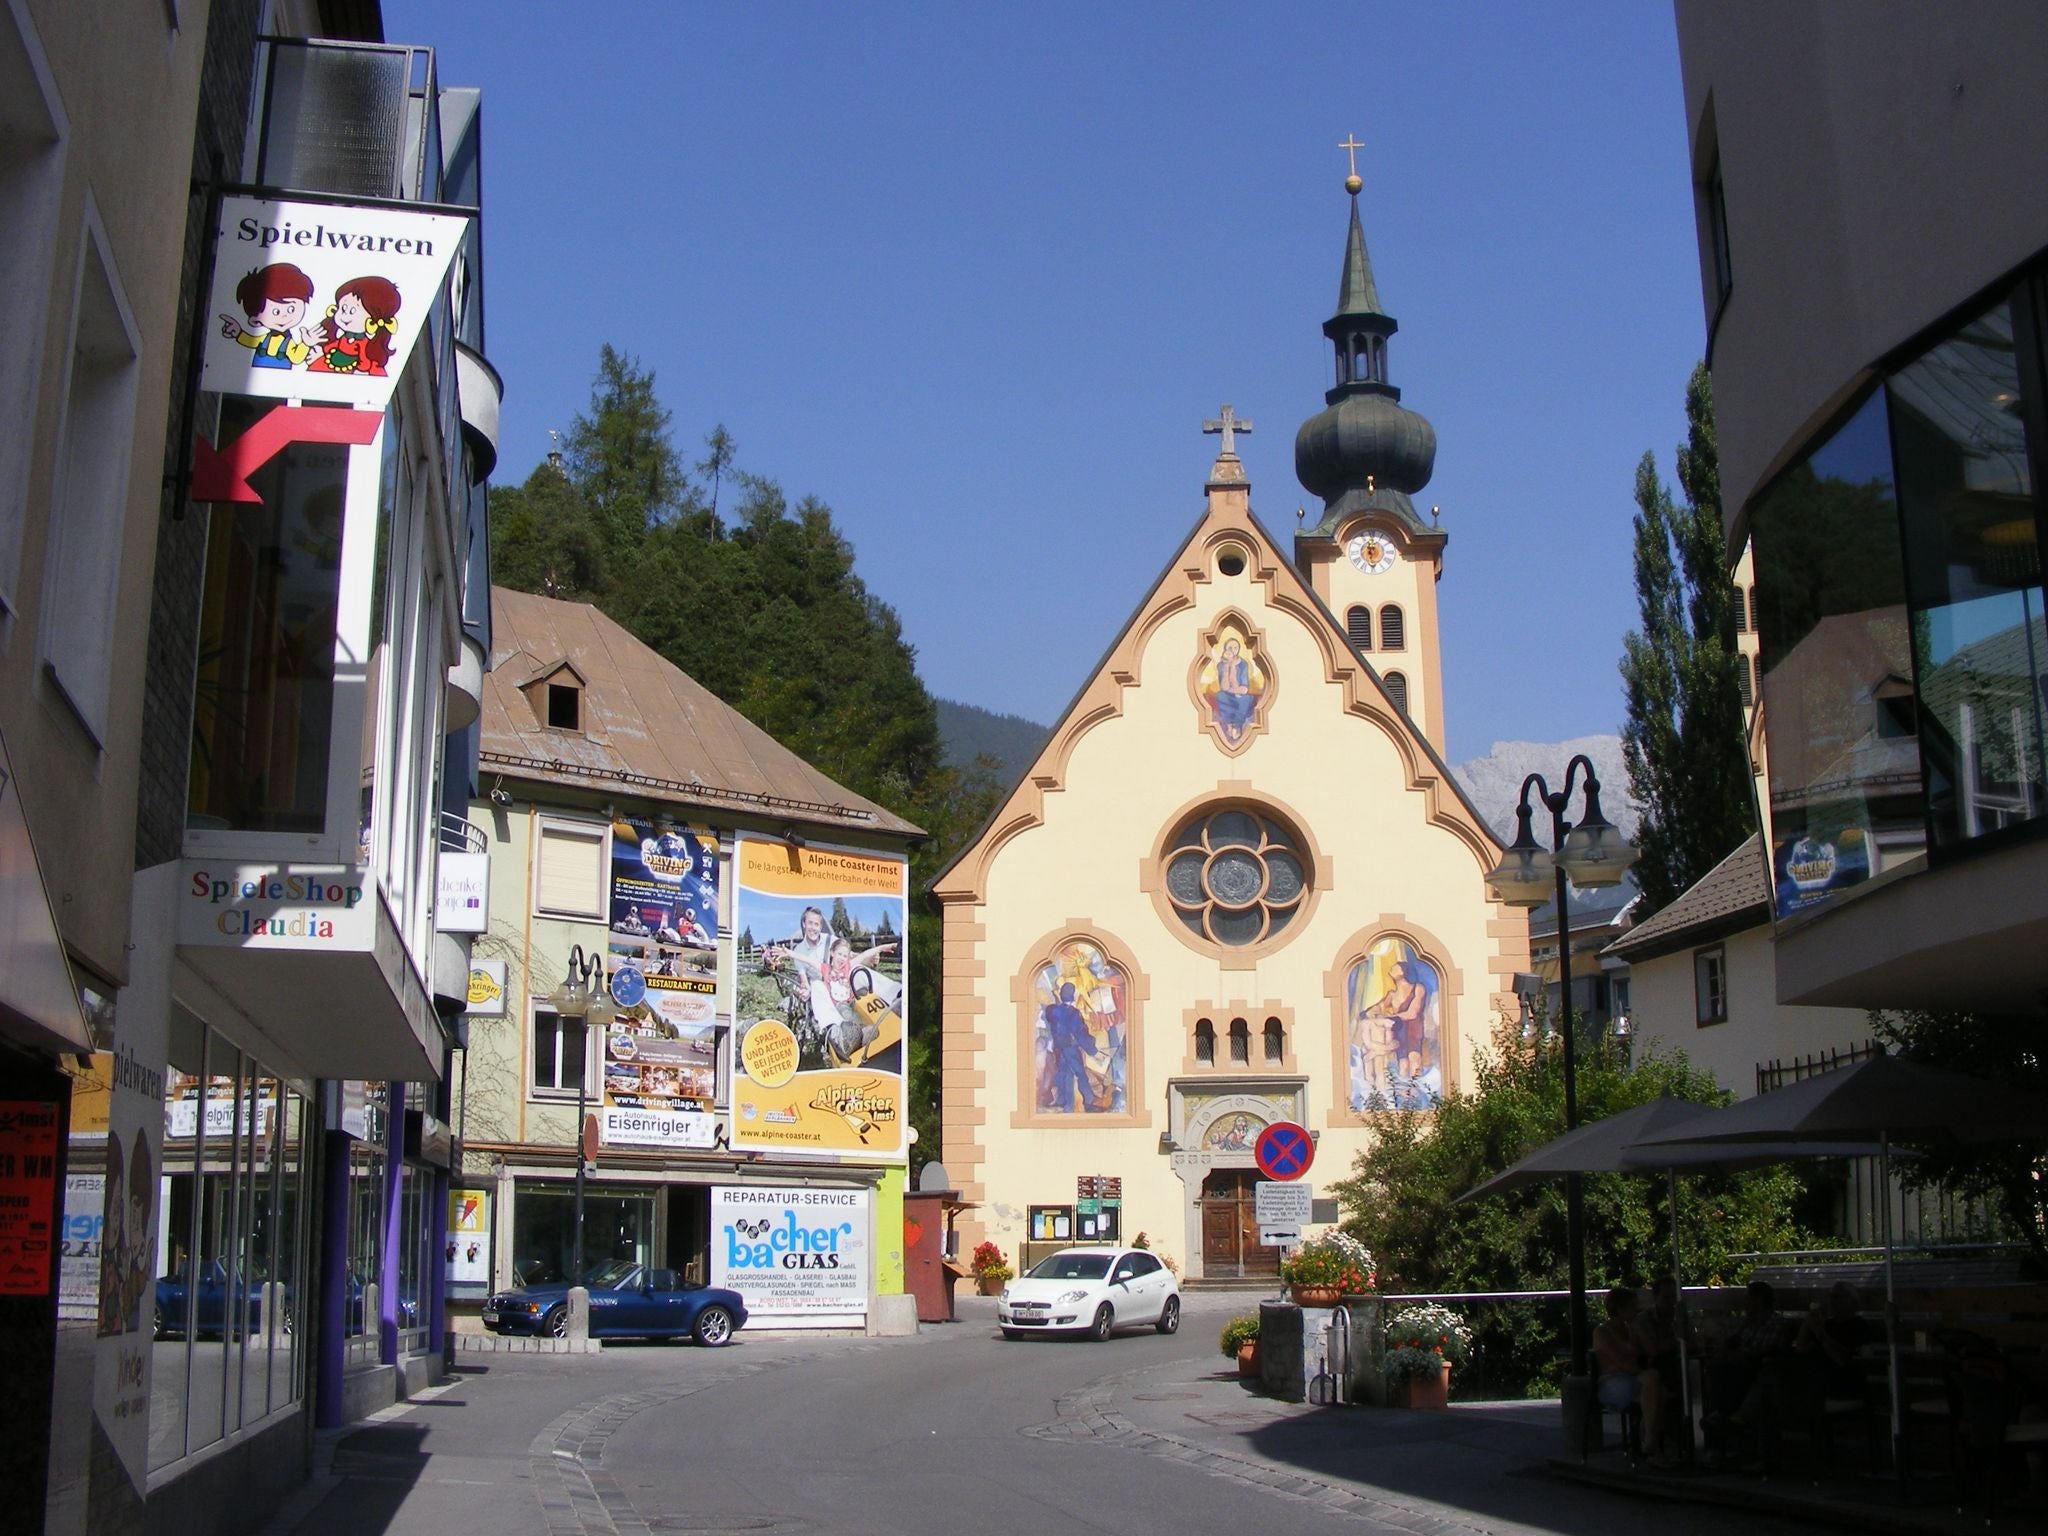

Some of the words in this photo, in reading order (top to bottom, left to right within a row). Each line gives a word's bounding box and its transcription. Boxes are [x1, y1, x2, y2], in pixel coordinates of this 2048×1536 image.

[237, 217, 434, 257] Spielwaren
[644, 854, 691, 868] DRIVING
[650, 864, 684, 876] VILLAGE
[808, 854, 838, 867] Alpine
[840, 858, 875, 872] Coaster
[877, 863, 898, 876] Imst
[748, 860, 762, 870] Die
[863, 877, 877, 887] der
[878, 879, 898, 889] Welt!
[217, 909, 334, 938] Claudia
[648, 978, 692, 991] RESTAURANT
[698, 982, 714, 993] CAFE
[867, 998, 885, 1013] 40
[755, 1030, 779, 1046] SPASS
[745, 1046, 764, 1061] UND
[765, 1036, 793, 1053] ACTION
[753, 1058, 767, 1070] BEI
[768, 1050, 793, 1066] JEDEM
[760, 1060, 793, 1079] WETTER
[614, 1096, 704, 1110] www.drivingvillage.at
[815, 1083, 865, 1106] Alpine
[624, 1111, 657, 1120] Autohaus
[835, 1098, 893, 1117] Coaster
[872, 1110, 896, 1122] Imst
[608, 1114, 691, 1136] Eisenrigler
[740, 1128, 821, 1141] www.alpine-coaster.at
[24, 1155, 52, 1178] WM
[724, 1192, 857, 1205] REPARATUR-SERVICE
[724, 1210, 852, 1268] bacher
[783, 1254, 839, 1269] GLAS
